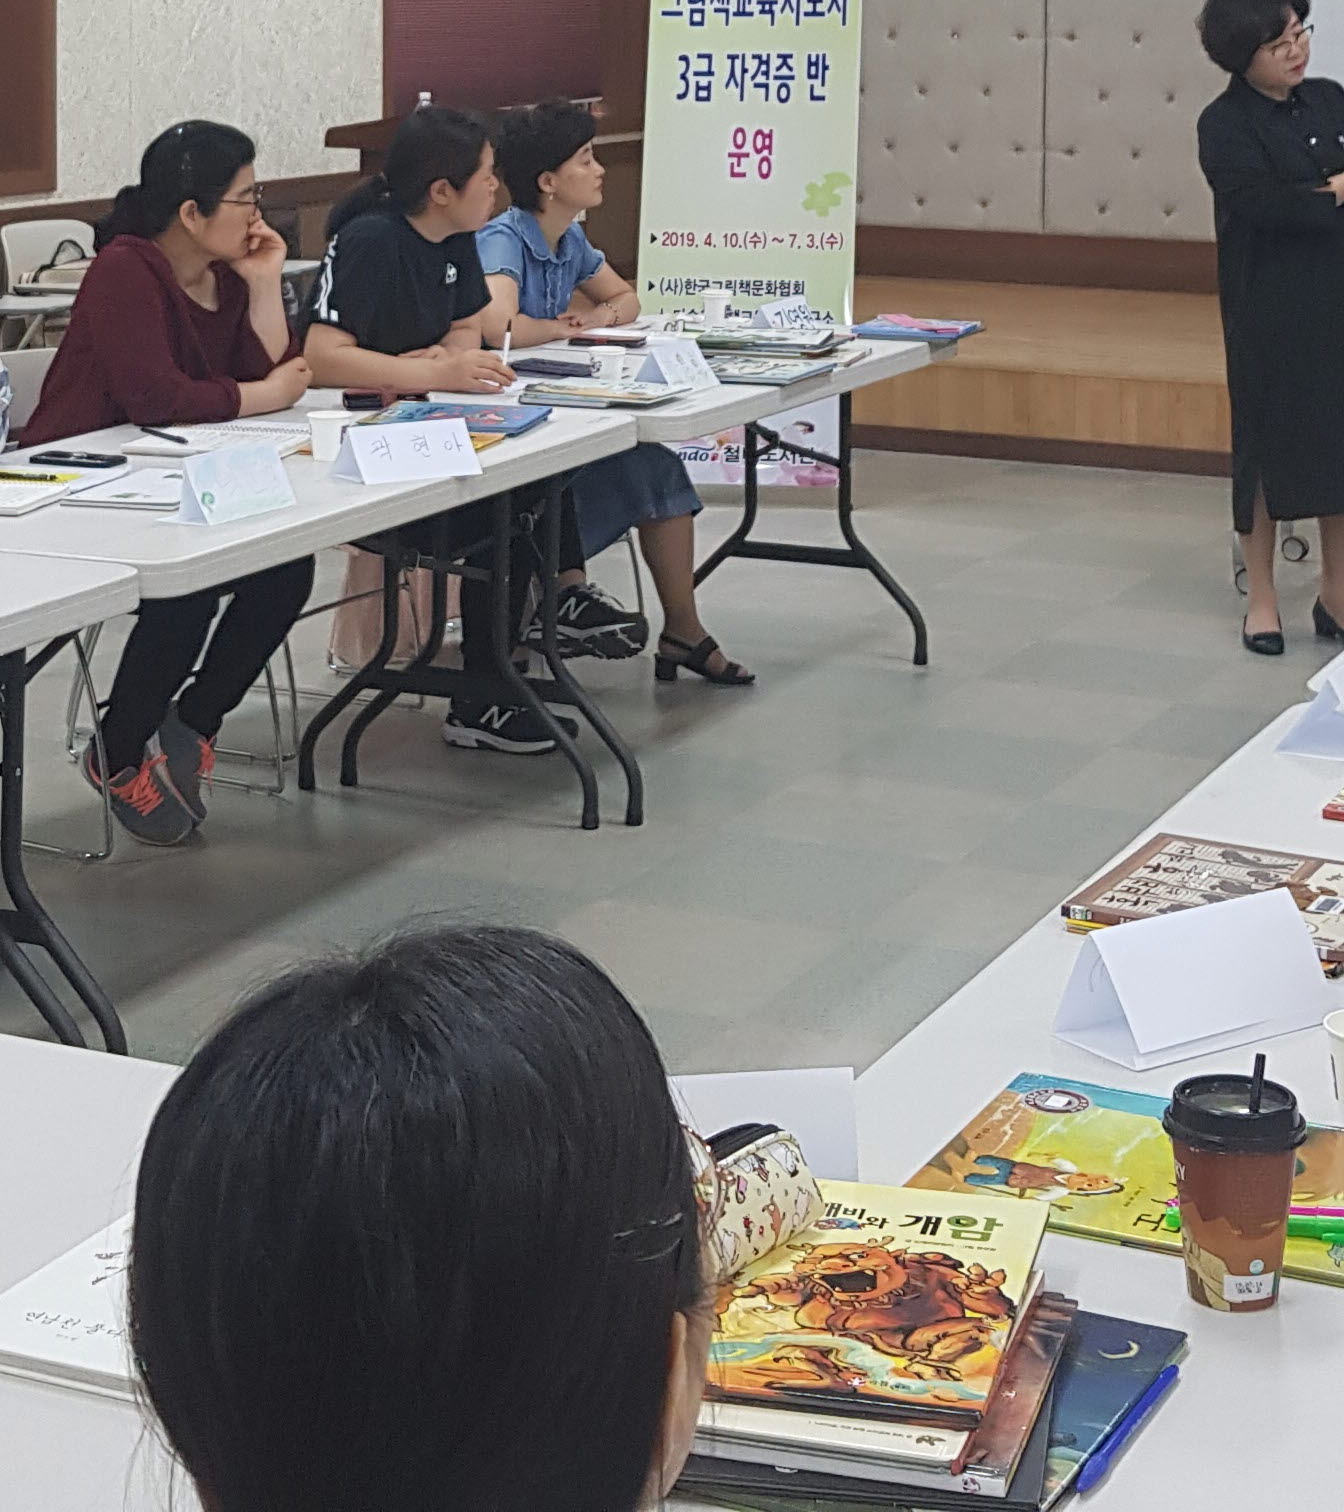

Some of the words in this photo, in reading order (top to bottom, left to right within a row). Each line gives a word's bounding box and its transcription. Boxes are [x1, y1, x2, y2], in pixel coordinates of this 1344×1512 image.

[675, 52, 715, 102] 3급
[724, 52, 796, 104] 자격증
[806, 52, 830, 102] 반
[727, 126, 774, 180] 운영
[661, 231, 698, 248] 2019.
[703, 232, 716, 248] 4.
[723, 230, 767, 250] 10.(수)
[788, 233, 801, 250] 7.
[806, 232, 844, 250] 3.(수)
[898, 1214, 1004, 1243] 개암
